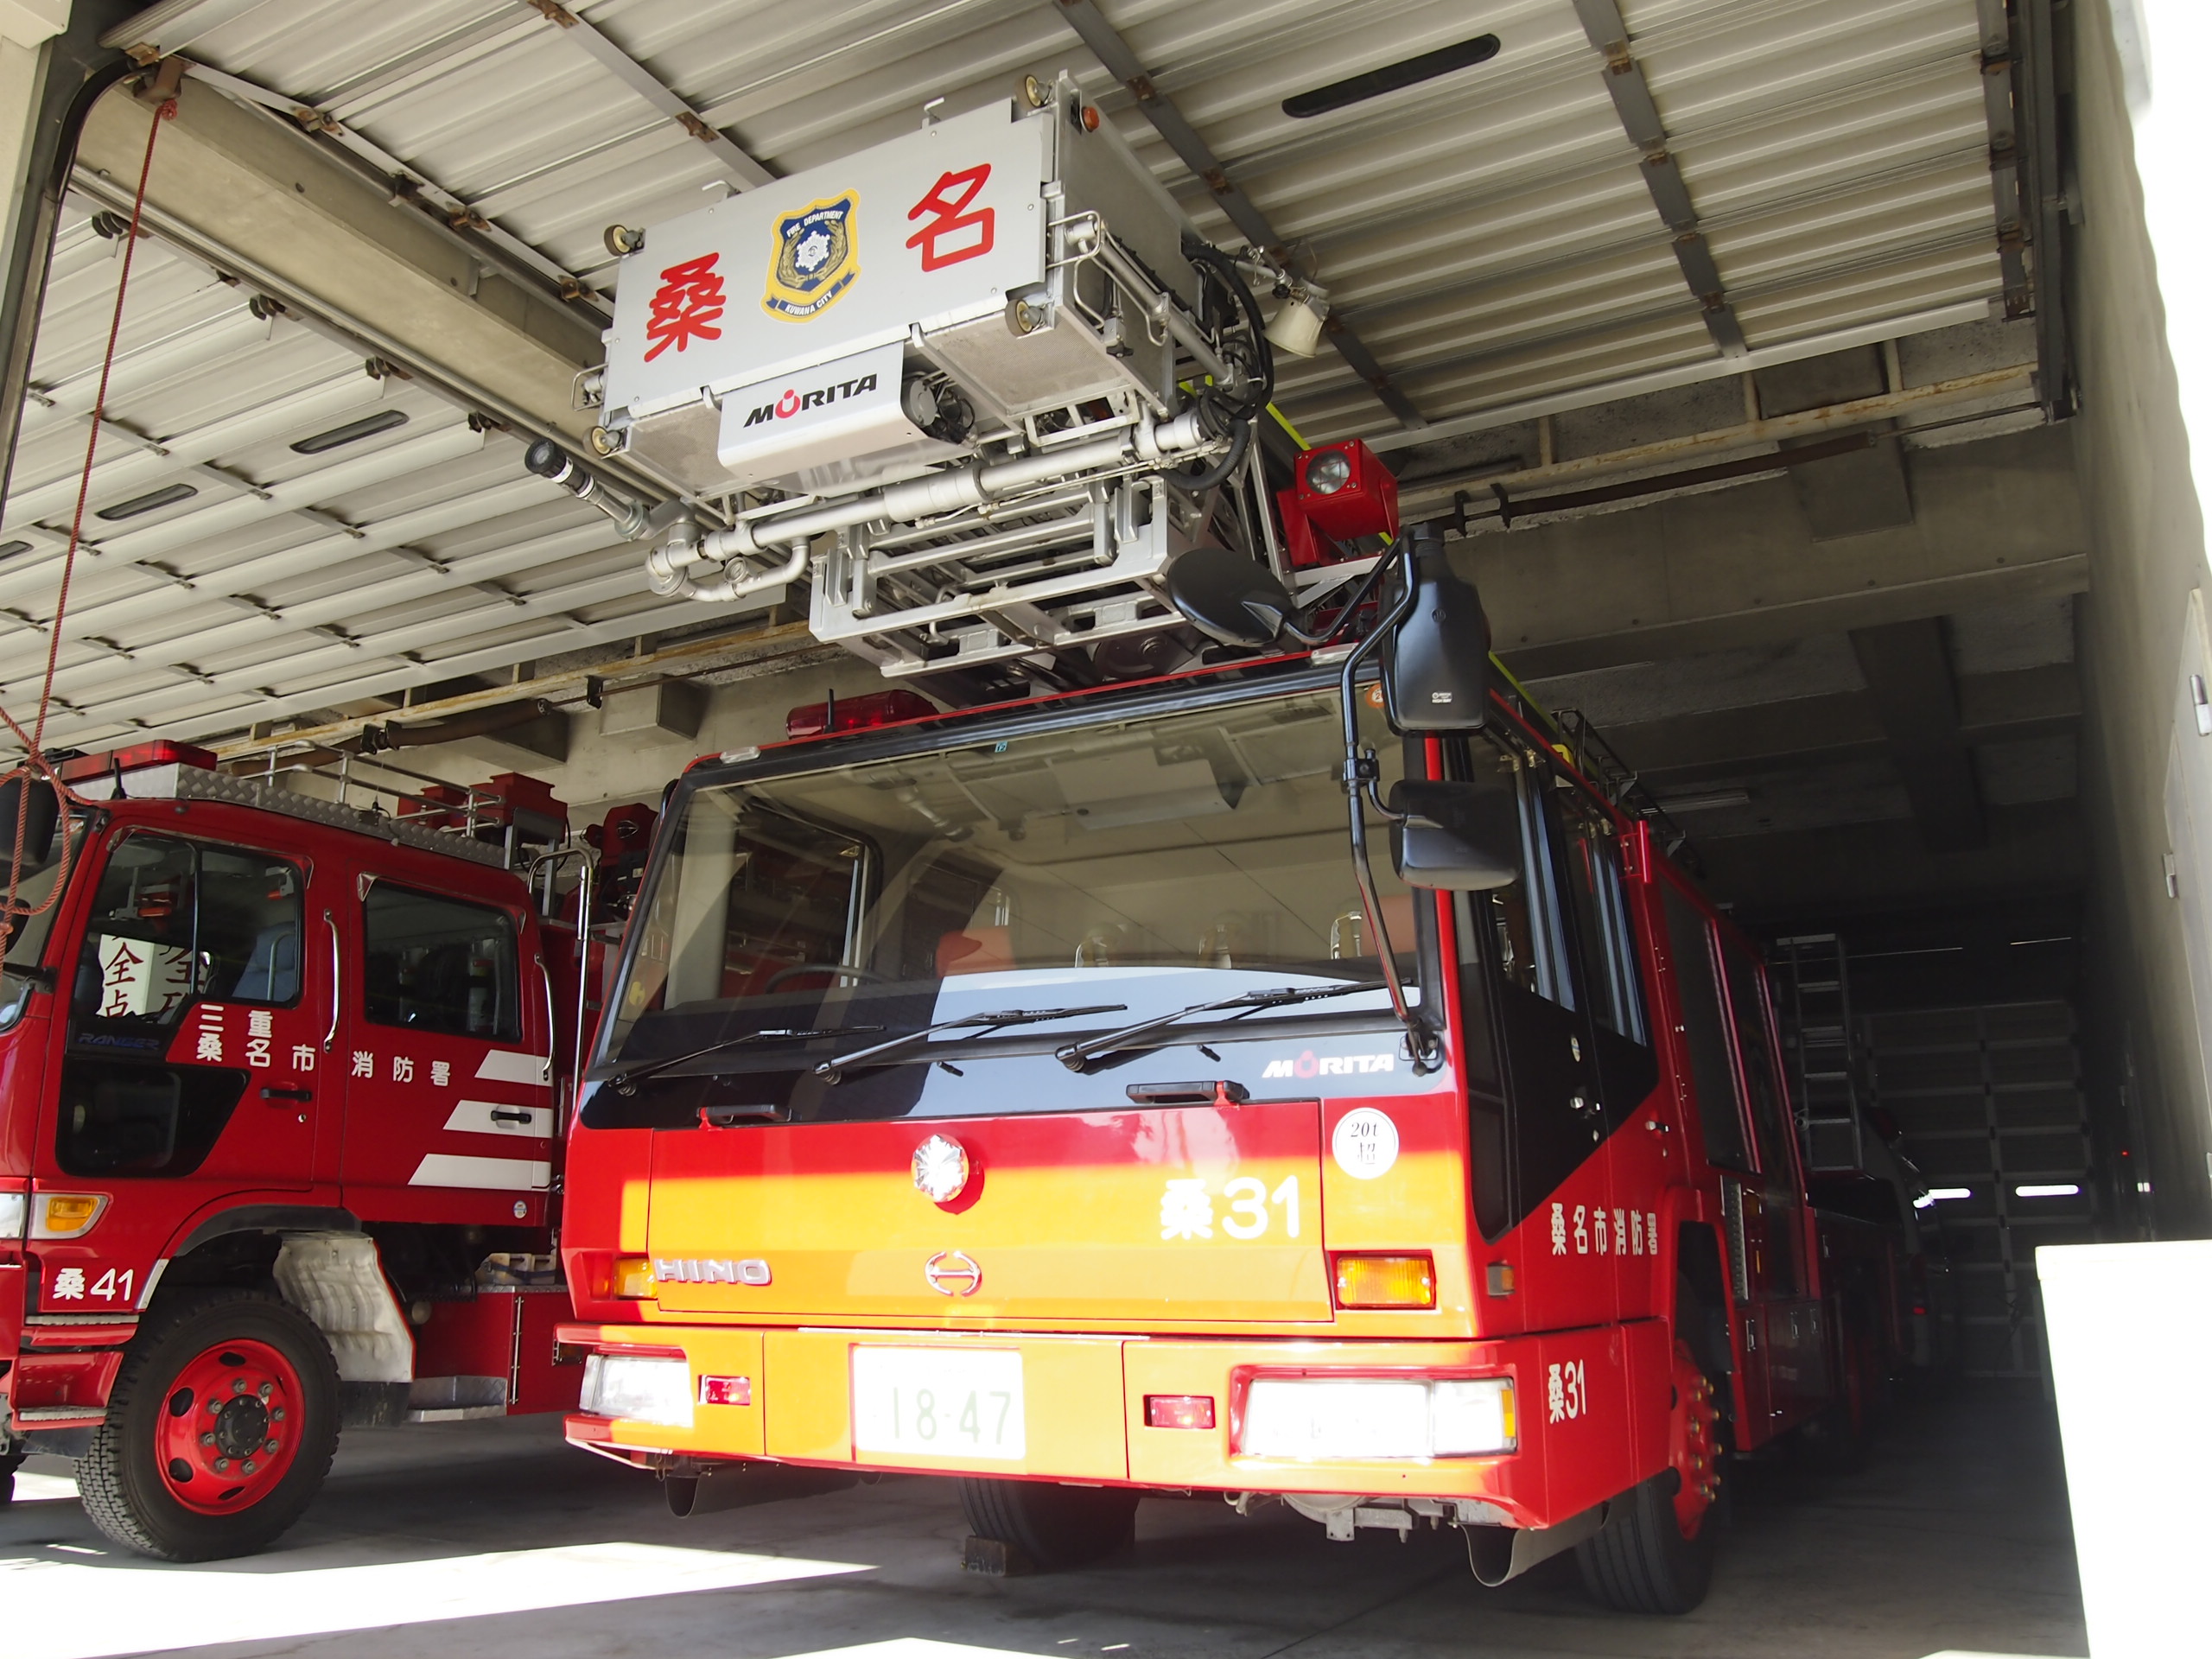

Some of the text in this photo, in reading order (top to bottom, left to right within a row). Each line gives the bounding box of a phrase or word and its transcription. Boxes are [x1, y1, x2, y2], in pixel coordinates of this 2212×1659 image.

[786, 210, 843, 238] FIRE DEPARTMENT
[645, 162, 995, 362] 桑 名
[785, 290, 833, 315] KUWANA CITY
[743, 373, 877, 429] MORITA
[77, 1033, 161, 1050] RANGER
[1262, 1050, 1395, 1078] MORITA
[1351, 1122, 1378, 1137] 20t
[1160, 1174, 1300, 1241] 桑31
[1550, 1202, 1658, 1255] 桑名市消防署
[653, 1258, 772, 1286] HINO
[1548, 1358, 1586, 1424] 桑31
